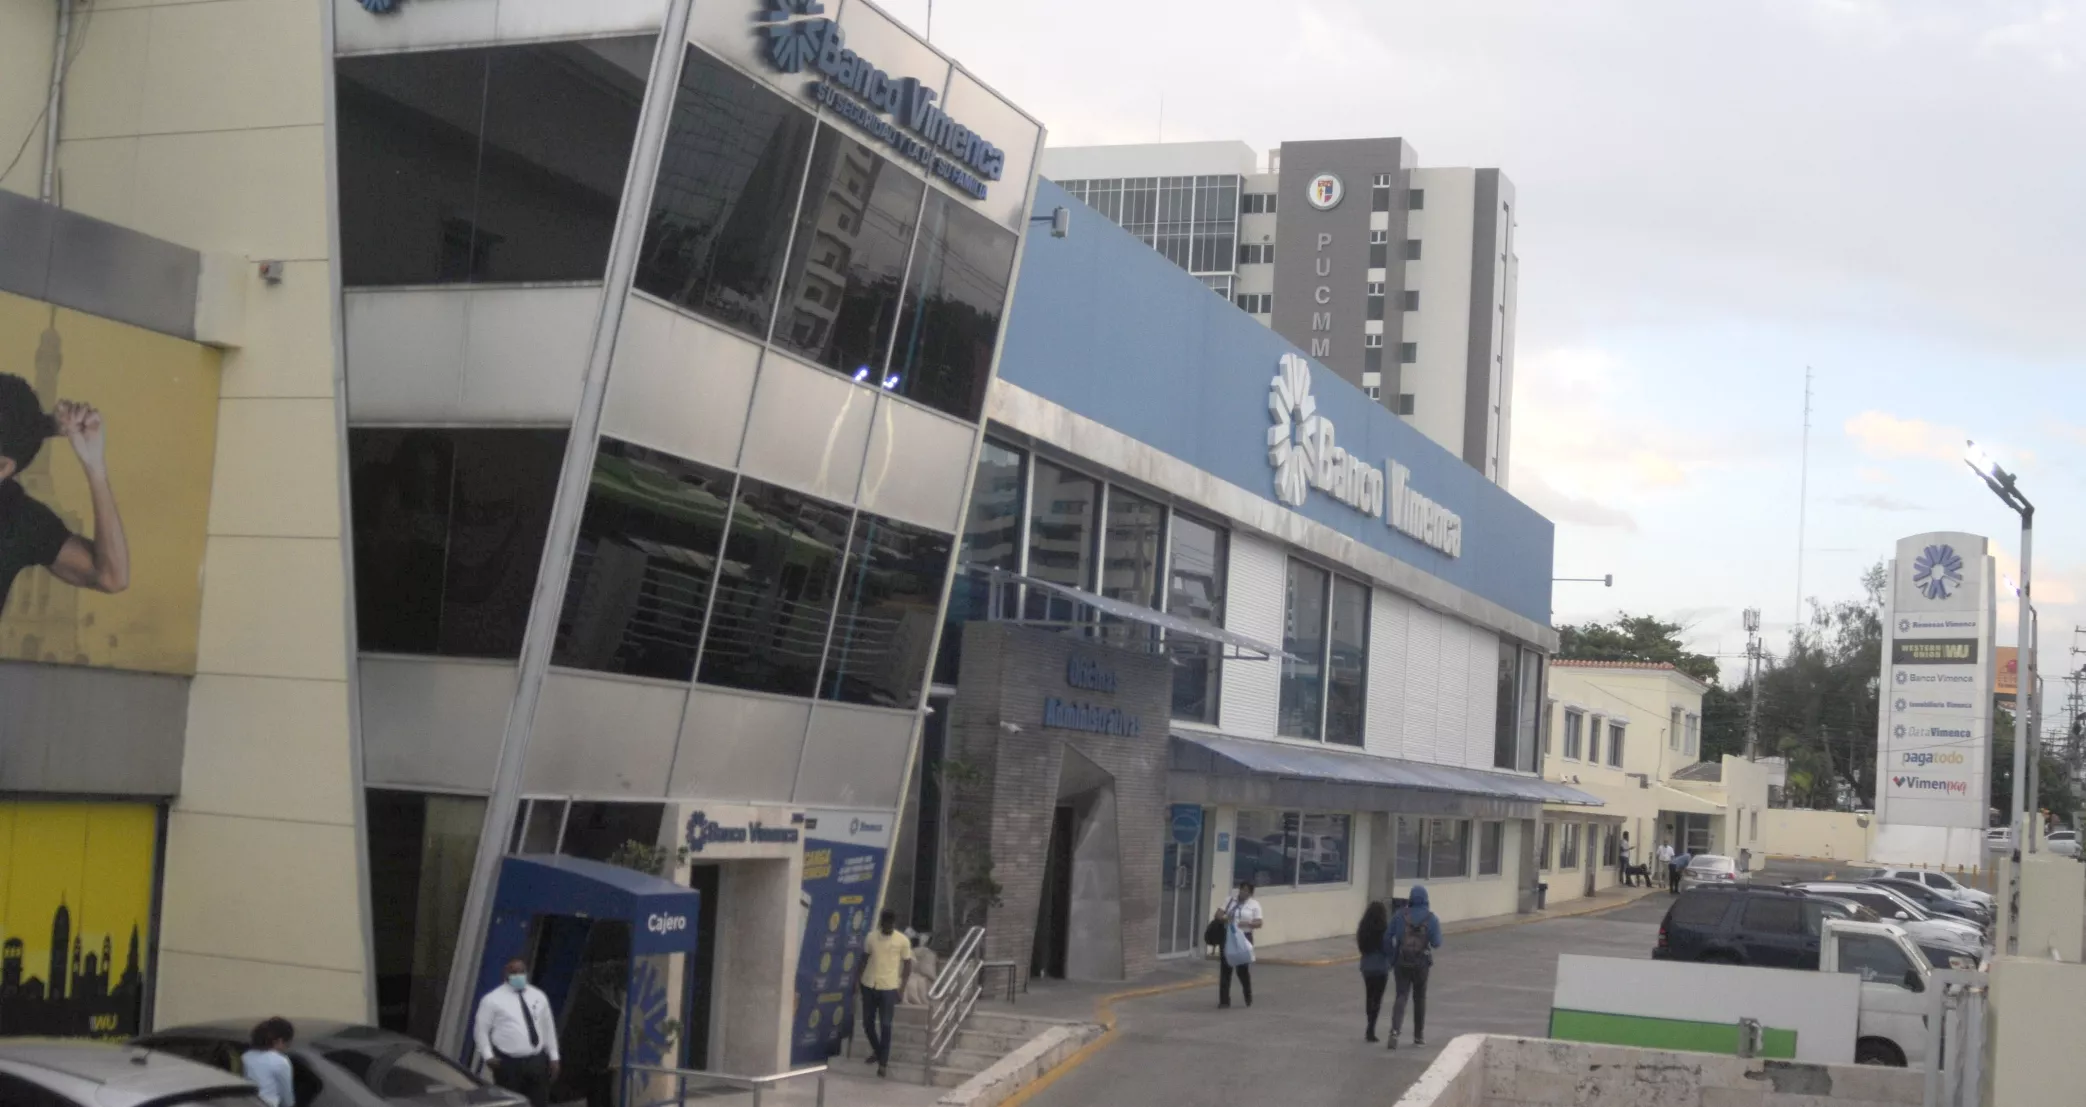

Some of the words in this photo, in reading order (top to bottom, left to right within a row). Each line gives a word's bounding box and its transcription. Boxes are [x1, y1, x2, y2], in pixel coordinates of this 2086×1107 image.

[818, 19, 905, 117] Banco
[904, 77, 1005, 181] Vimenca
[817, 83, 836, 107] SU
[835, 95, 897, 146] SEGURIDAD
[951, 166, 988, 200] FAMILIA
[1311, 232, 1332, 357] PUCMM
[1310, 415, 1384, 518] Banco
[1385, 458, 1462, 558] Vimenca
[1912, 621, 1944, 629] Remesas
[1945, 620, 1977, 628] Vimenca
[1901, 644, 1942, 652] WESTERN
[1944, 644, 1970, 659] WU
[1912, 651, 1942, 659] UNION
[1909, 673, 1936, 682] Banco
[1937, 673, 1974, 683] Vimenca
[1902, 751, 1964, 767] pagatodo
[704, 821, 746, 843] Banco
[748, 820, 799, 843] Vimenca
[648, 912, 687, 935] Cajero
